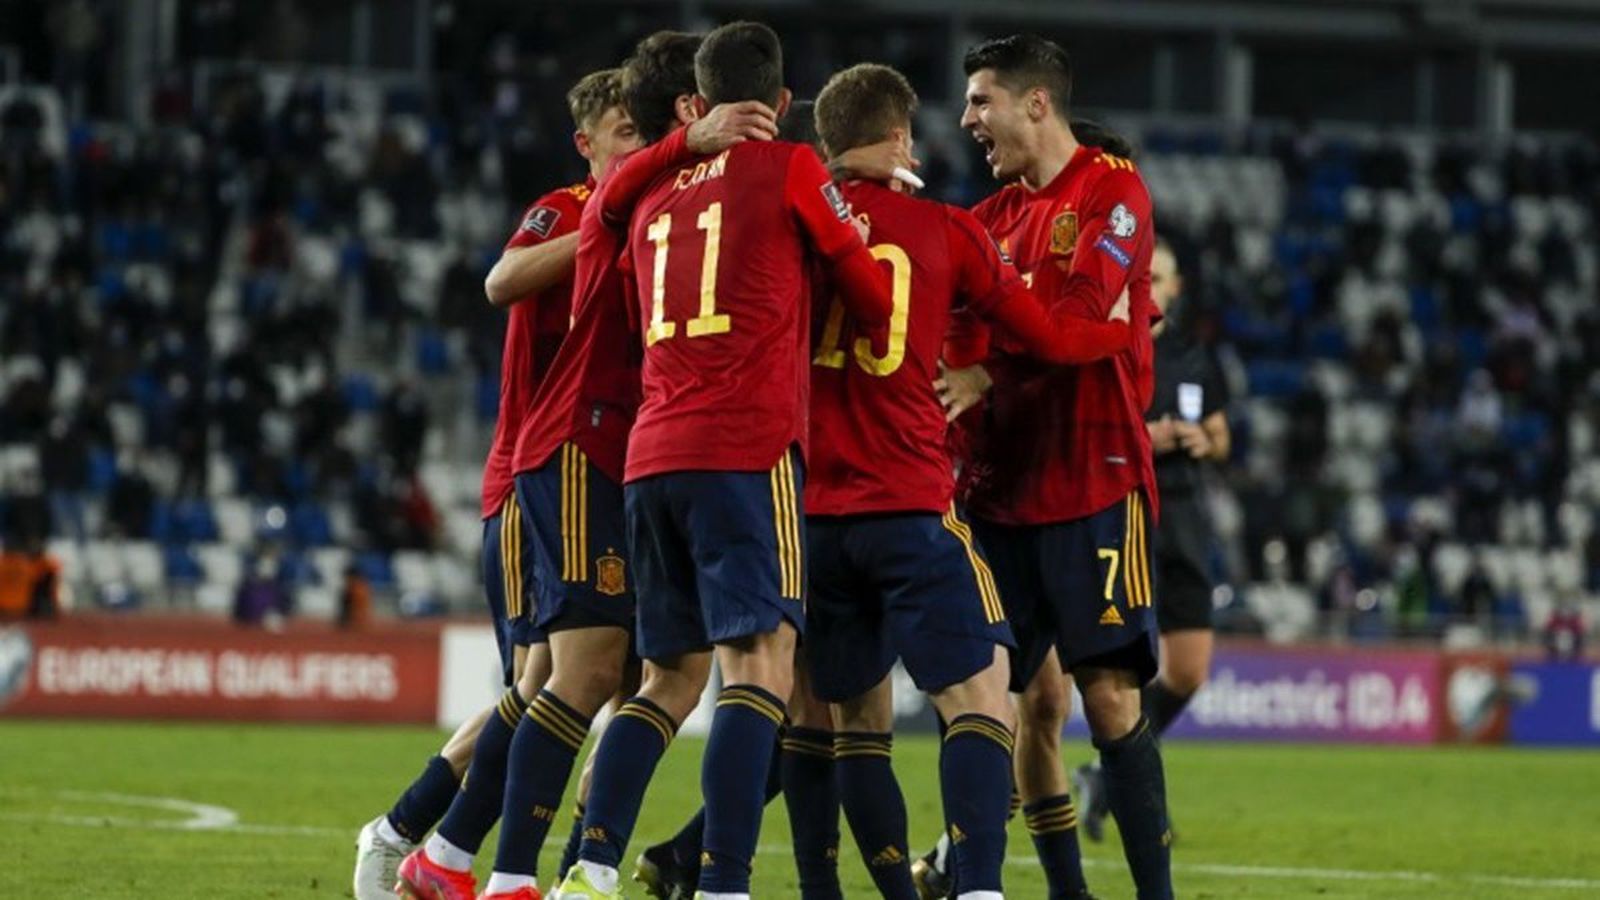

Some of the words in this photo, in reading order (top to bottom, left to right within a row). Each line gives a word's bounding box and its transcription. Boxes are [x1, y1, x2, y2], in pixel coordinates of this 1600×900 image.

[646, 202, 731, 347] 11
[1097, 547, 1119, 600] 7
[38, 646, 212, 694] EUROPEAN
[217, 650, 397, 699] QUALIFIERS
